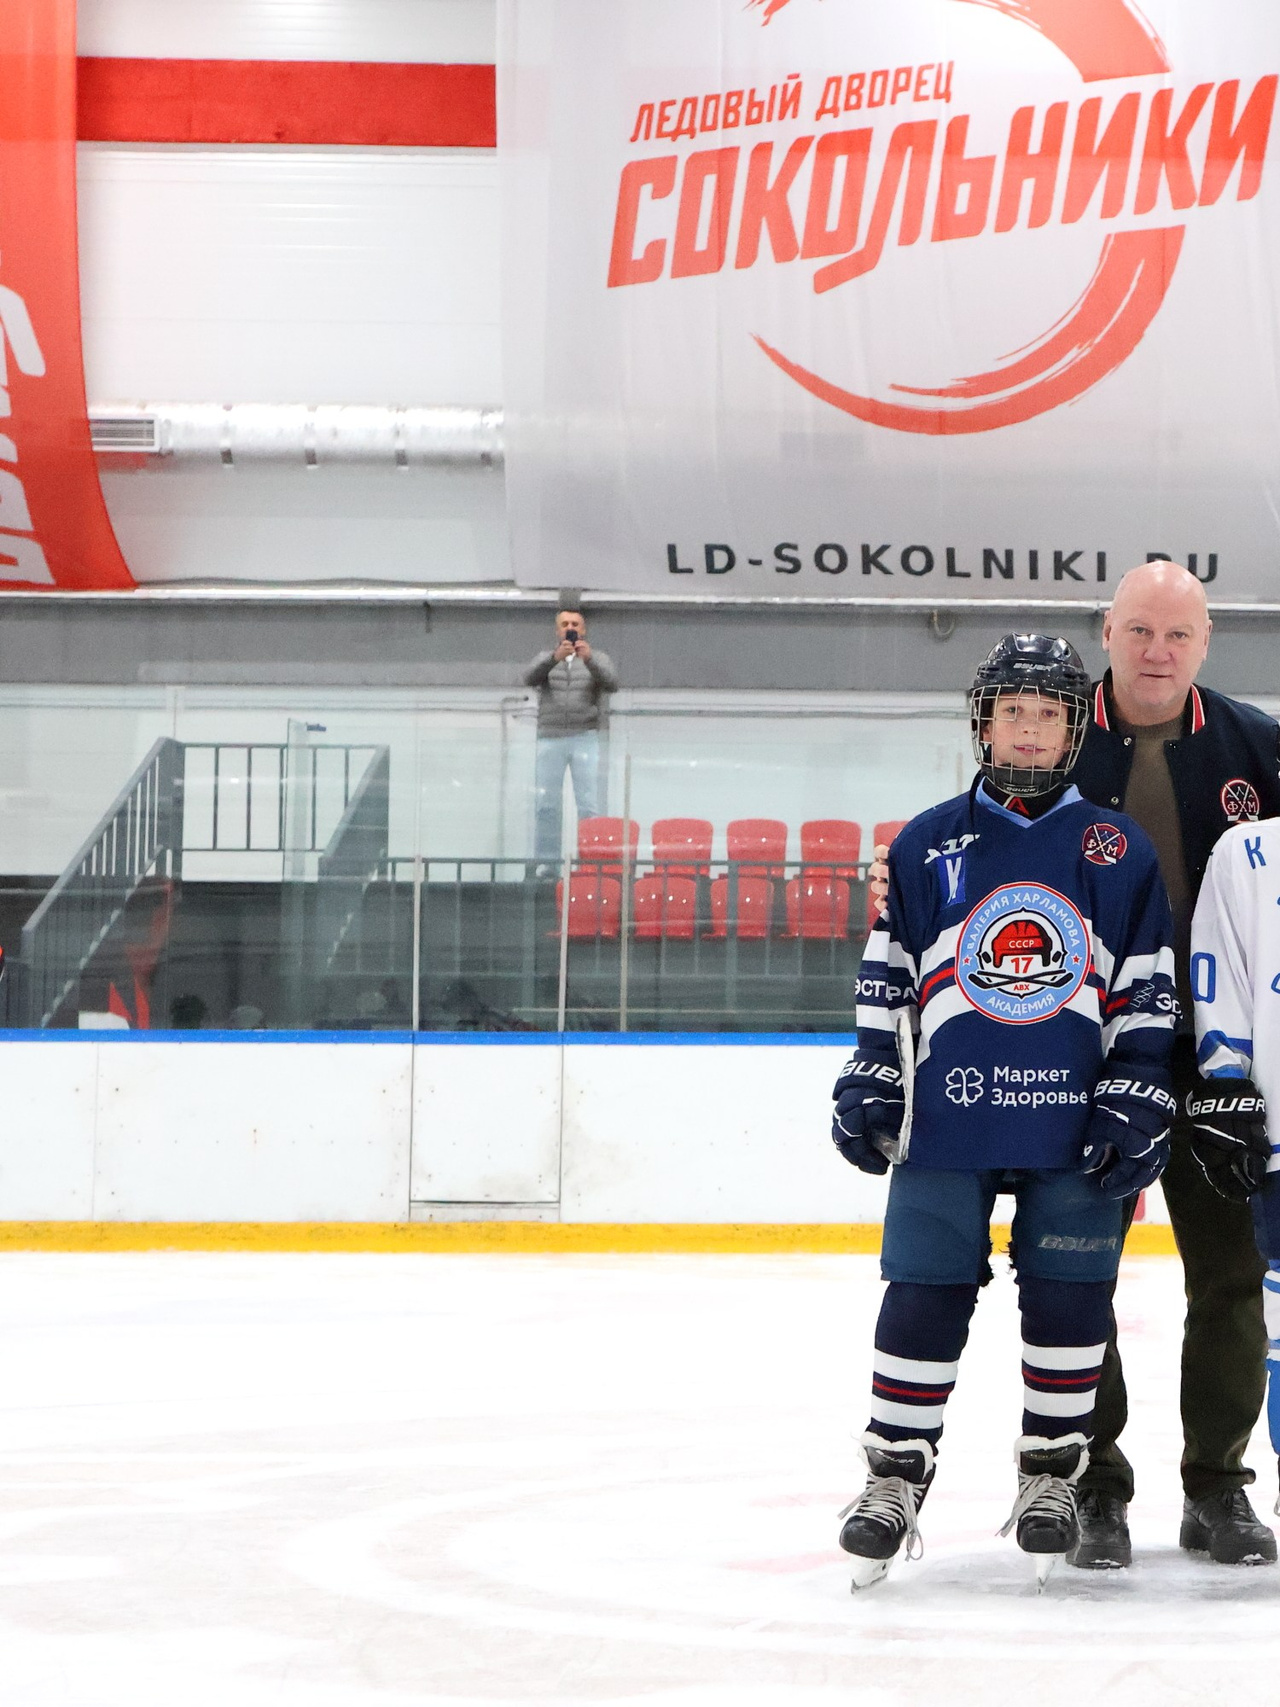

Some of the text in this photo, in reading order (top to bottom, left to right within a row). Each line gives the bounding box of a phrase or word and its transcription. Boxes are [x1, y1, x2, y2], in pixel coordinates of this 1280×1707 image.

[629, 60, 955, 143] ЛЕДОВЫЙ ДВОРЕЦ
[607, 74, 1279, 294] СОКОЛЬНИКИ
[667, 542, 1218, 583] LD-SOKOLNIKIU
[1227, 801, 1256, 812] ФХМ
[1086, 838, 1119, 856] ФХМ
[967, 893, 1080, 949] ВАЛЕРИЯ ХАРЛАМОВА
[1008, 940, 1035, 949] СССР
[1010, 957, 1034, 974] 17
[986, 993, 1056, 1016] АКАДЕМИЯ
[840, 1061, 904, 1087] AUE
[993, 1066, 1070, 1086] Маркет
[991, 1088, 1088, 1109] Здоровье
[1093, 1079, 1177, 1117] BAUER
[1191, 1097, 1266, 1117] BAUER
